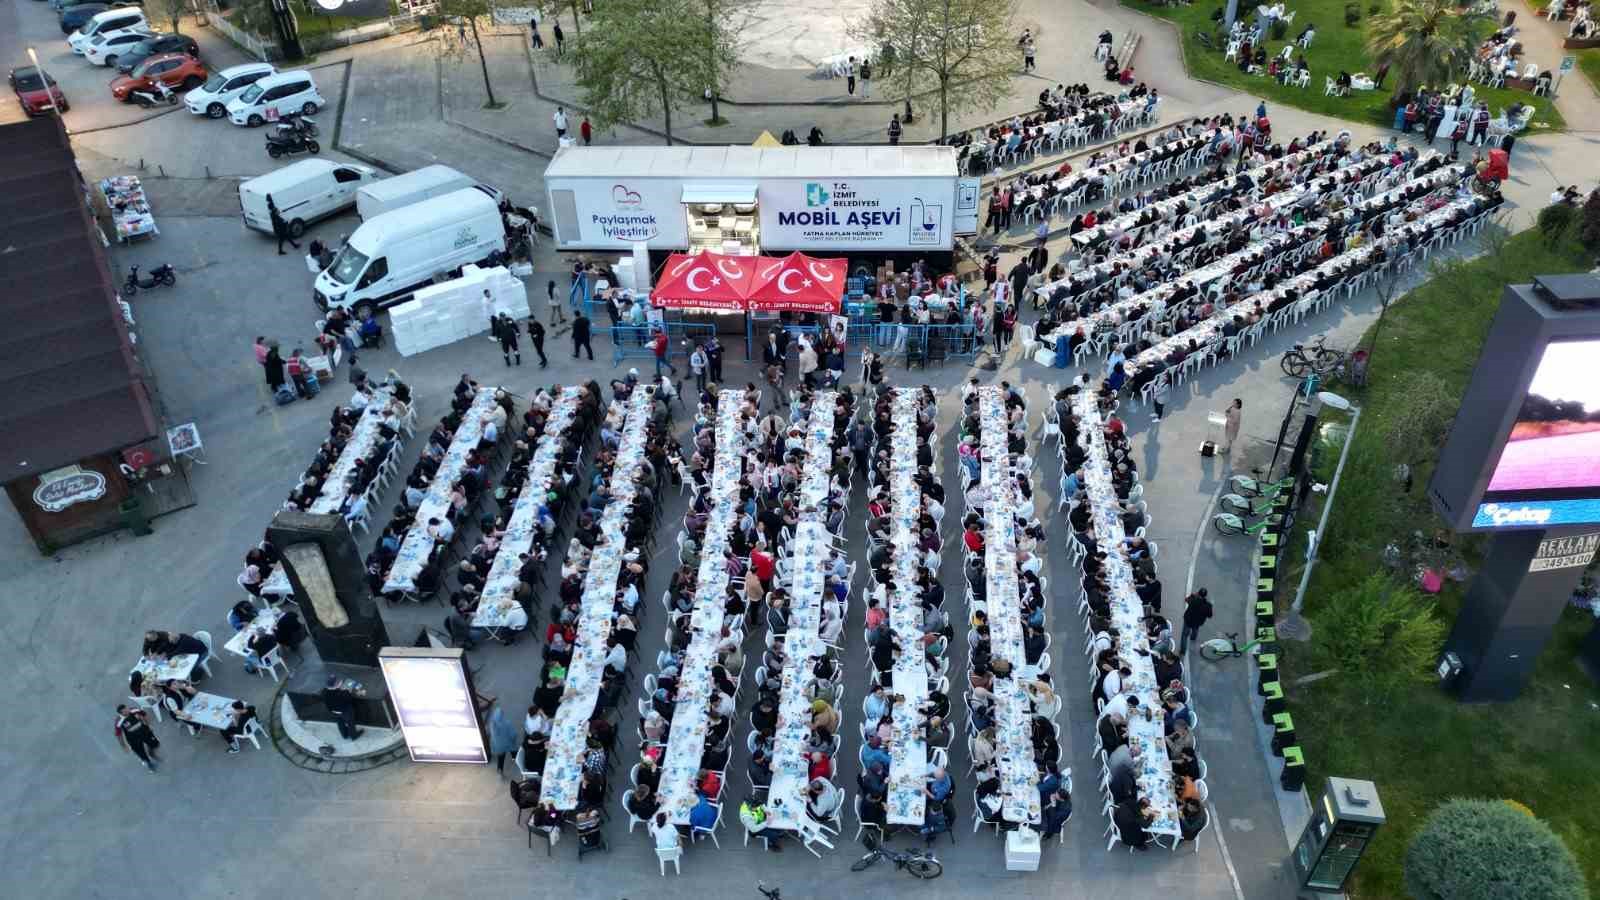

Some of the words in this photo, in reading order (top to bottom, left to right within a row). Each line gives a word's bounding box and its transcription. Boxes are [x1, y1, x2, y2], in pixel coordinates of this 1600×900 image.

[592, 214, 657, 226] Paylaşmak
[778, 207, 840, 226] MOBİL
[846, 207, 901, 230] AŞEVİ
[1536, 535, 1599, 558] REKLAM
